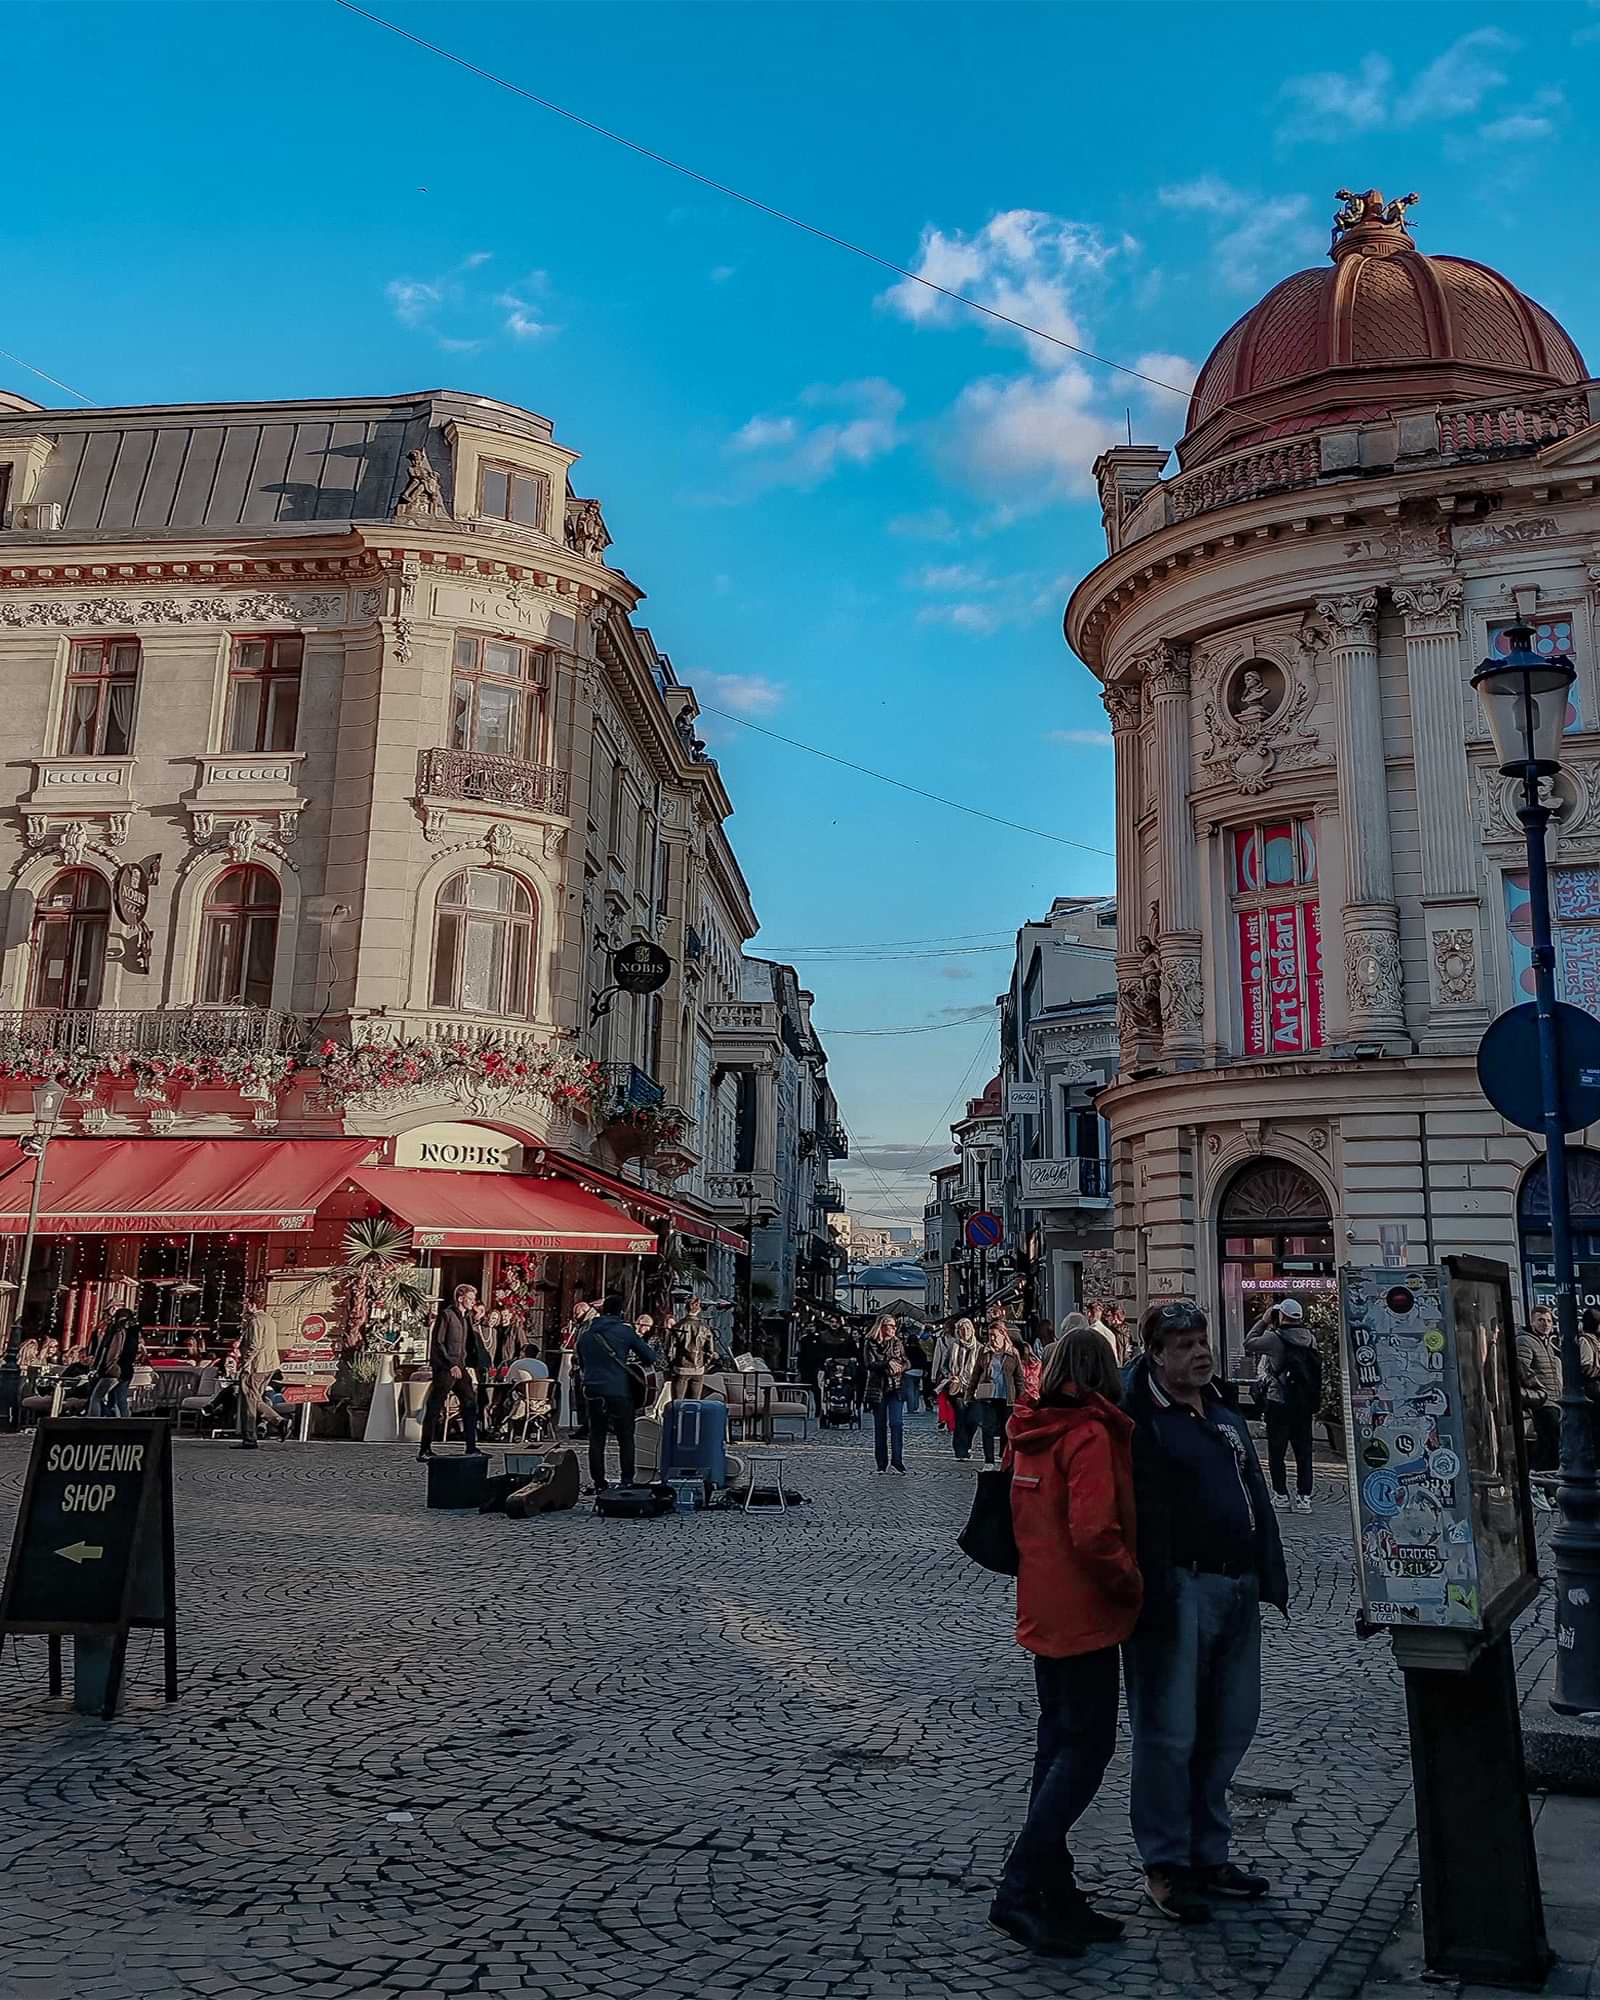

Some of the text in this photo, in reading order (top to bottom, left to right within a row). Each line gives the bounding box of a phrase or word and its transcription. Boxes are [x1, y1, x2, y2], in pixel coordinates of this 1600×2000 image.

[122, 885, 147, 905] NOBIS
[1247, 915, 1259, 945] visit
[620, 962, 664, 974] NOBIS
[1269, 911, 1299, 1046] Art Safari
[420, 1143, 501, 1165] NOBIS
[520, 1235, 561, 1249] NOBIS
[1241, 1280, 1256, 1289] BOB
[1259, 1280, 1288, 1289] GEORGE
[1292, 1279, 1320, 1289] COFFEE
[47, 1444, 144, 1472] SOUVENIR
[61, 1484, 116, 1512] SHOP
[1371, 1602, 1400, 1614] SEGA
